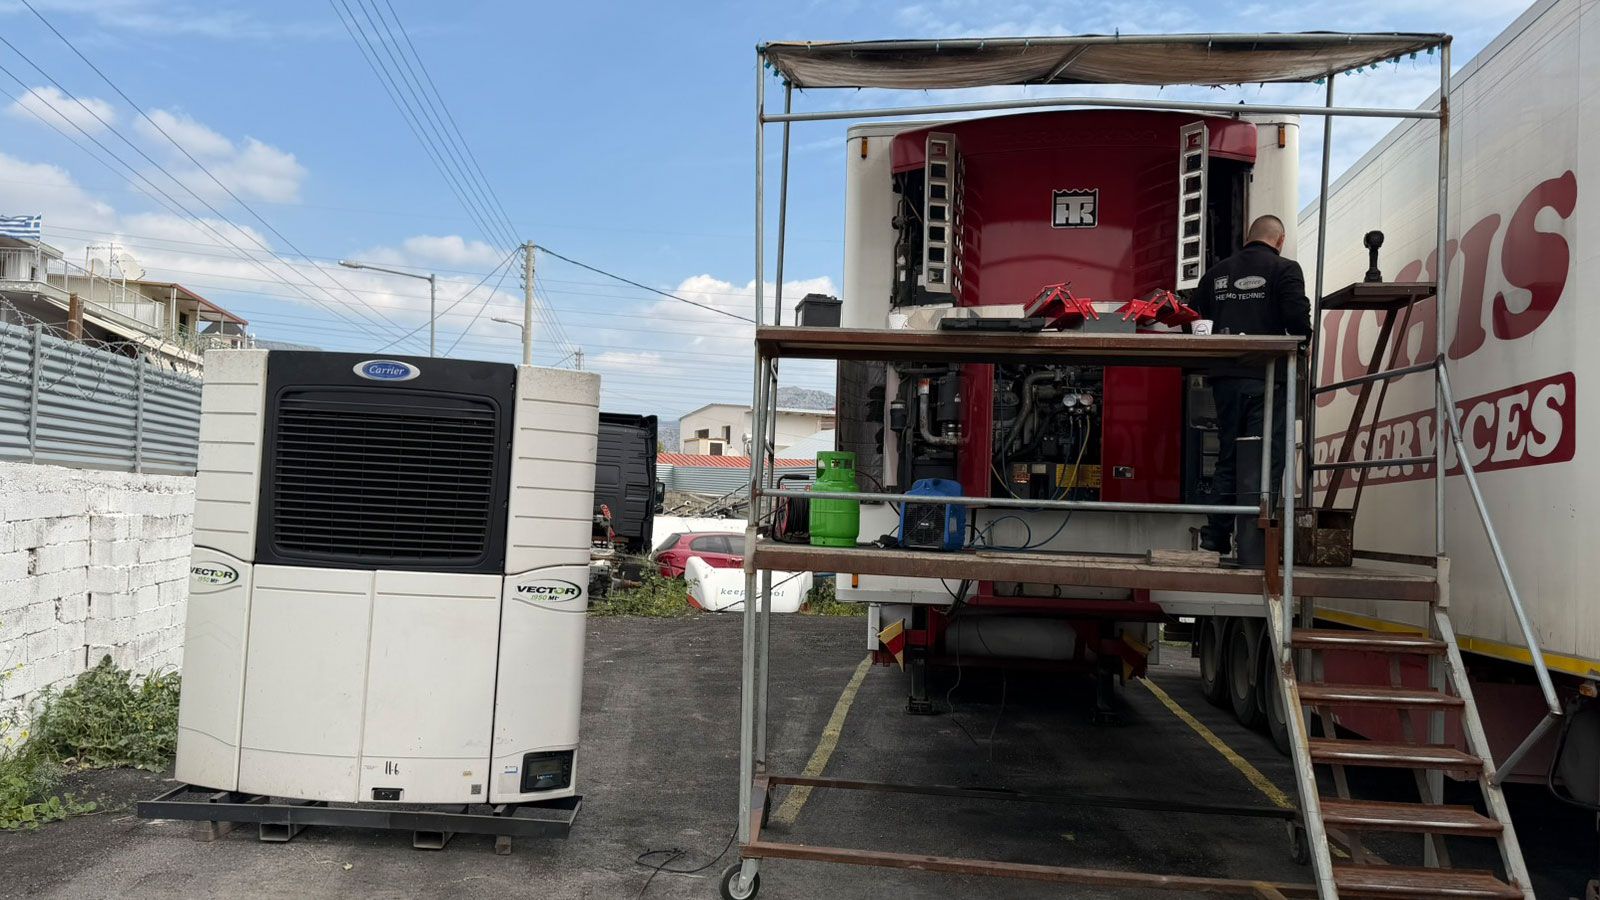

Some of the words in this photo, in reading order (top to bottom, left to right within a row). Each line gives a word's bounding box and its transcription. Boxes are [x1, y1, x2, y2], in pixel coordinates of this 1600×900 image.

[1237, 291, 1265, 300] TECHNIC
[369, 365, 405, 376] Carrier
[190, 566, 233, 579] VECTOR
[517, 585, 576, 595] VECTOR
